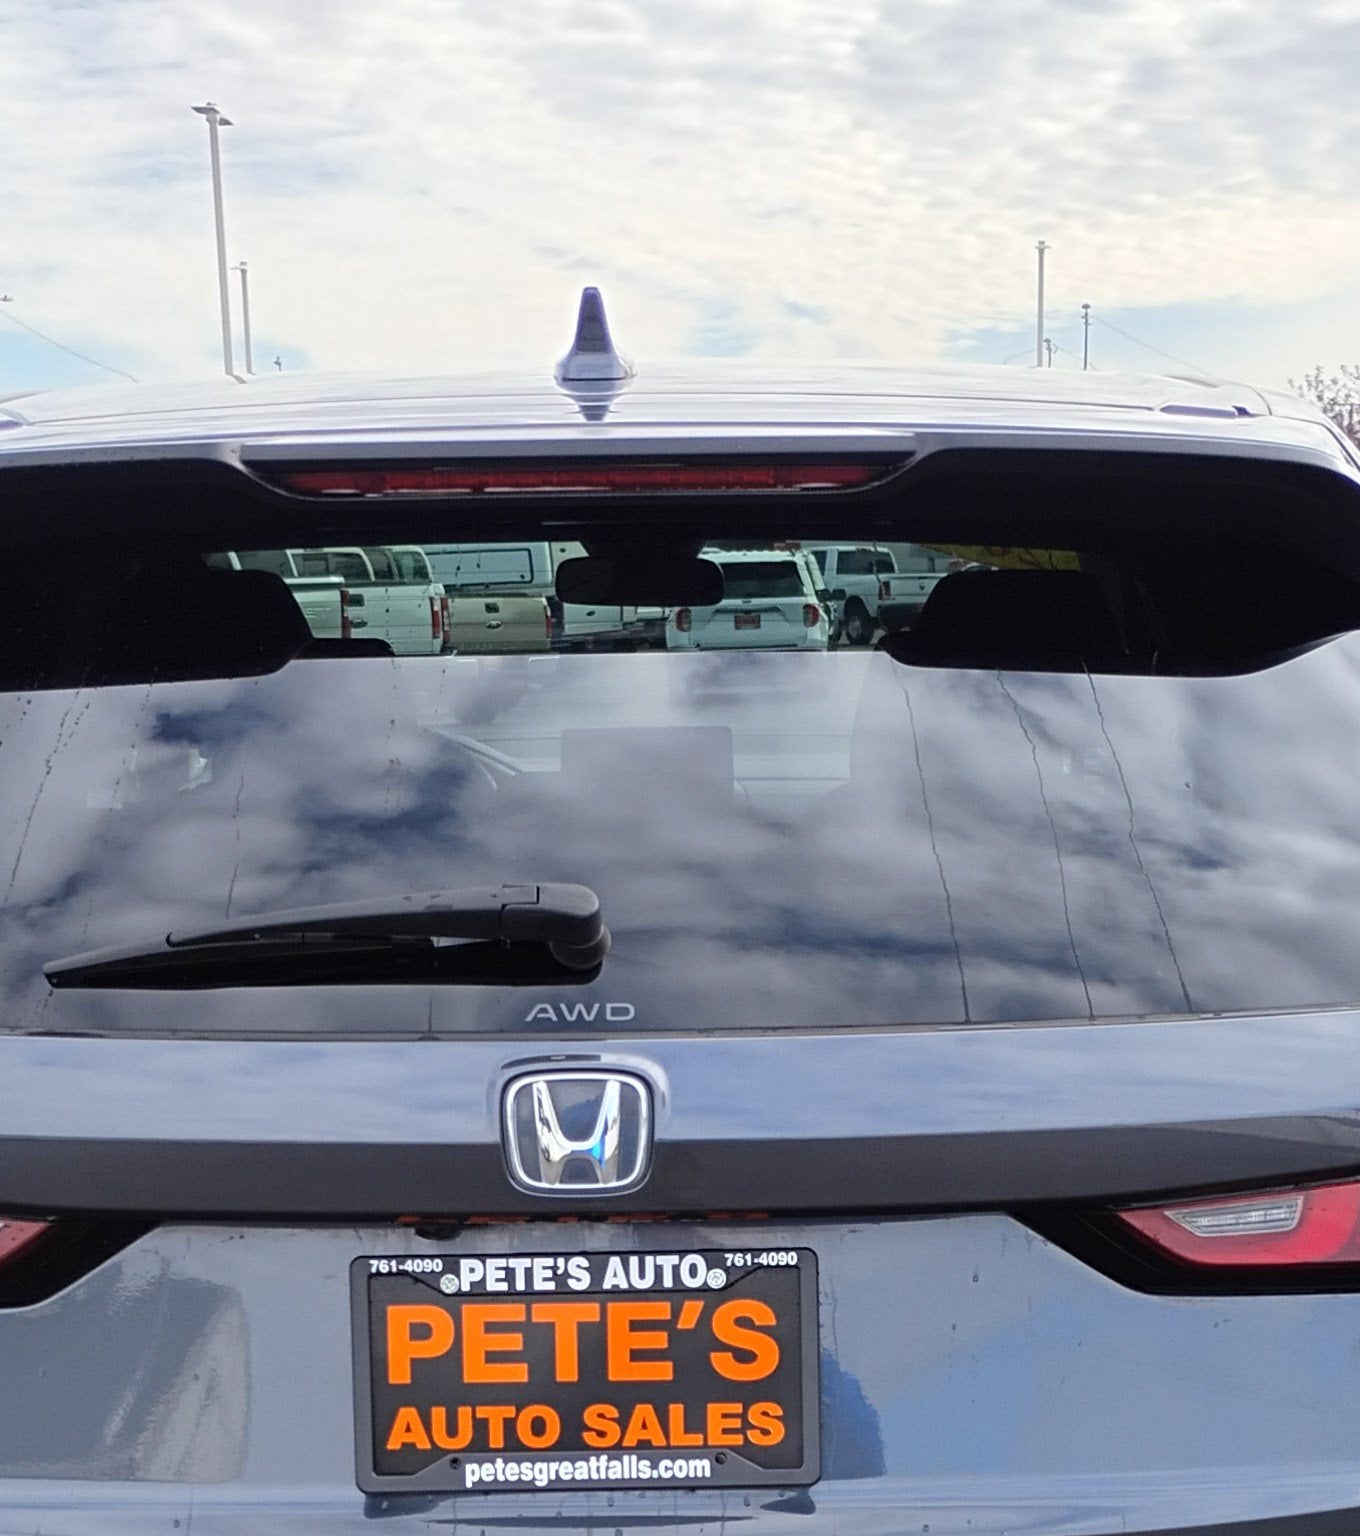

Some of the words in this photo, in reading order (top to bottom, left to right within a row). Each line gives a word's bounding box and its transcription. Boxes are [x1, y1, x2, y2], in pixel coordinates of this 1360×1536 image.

[525, 1002, 635, 1022] AWD
[368, 1258, 443, 1274] 761-4090
[459, 1256, 591, 1292] PETE'S
[602, 1253, 708, 1290] AUTO
[724, 1251, 798, 1267] 761-4090
[386, 1298, 780, 1385] PETE'S
[386, 1404, 561, 1451] AUTO
[581, 1401, 786, 1448] SALES
[464, 1454, 711, 1489] petesgreatfalls.com
